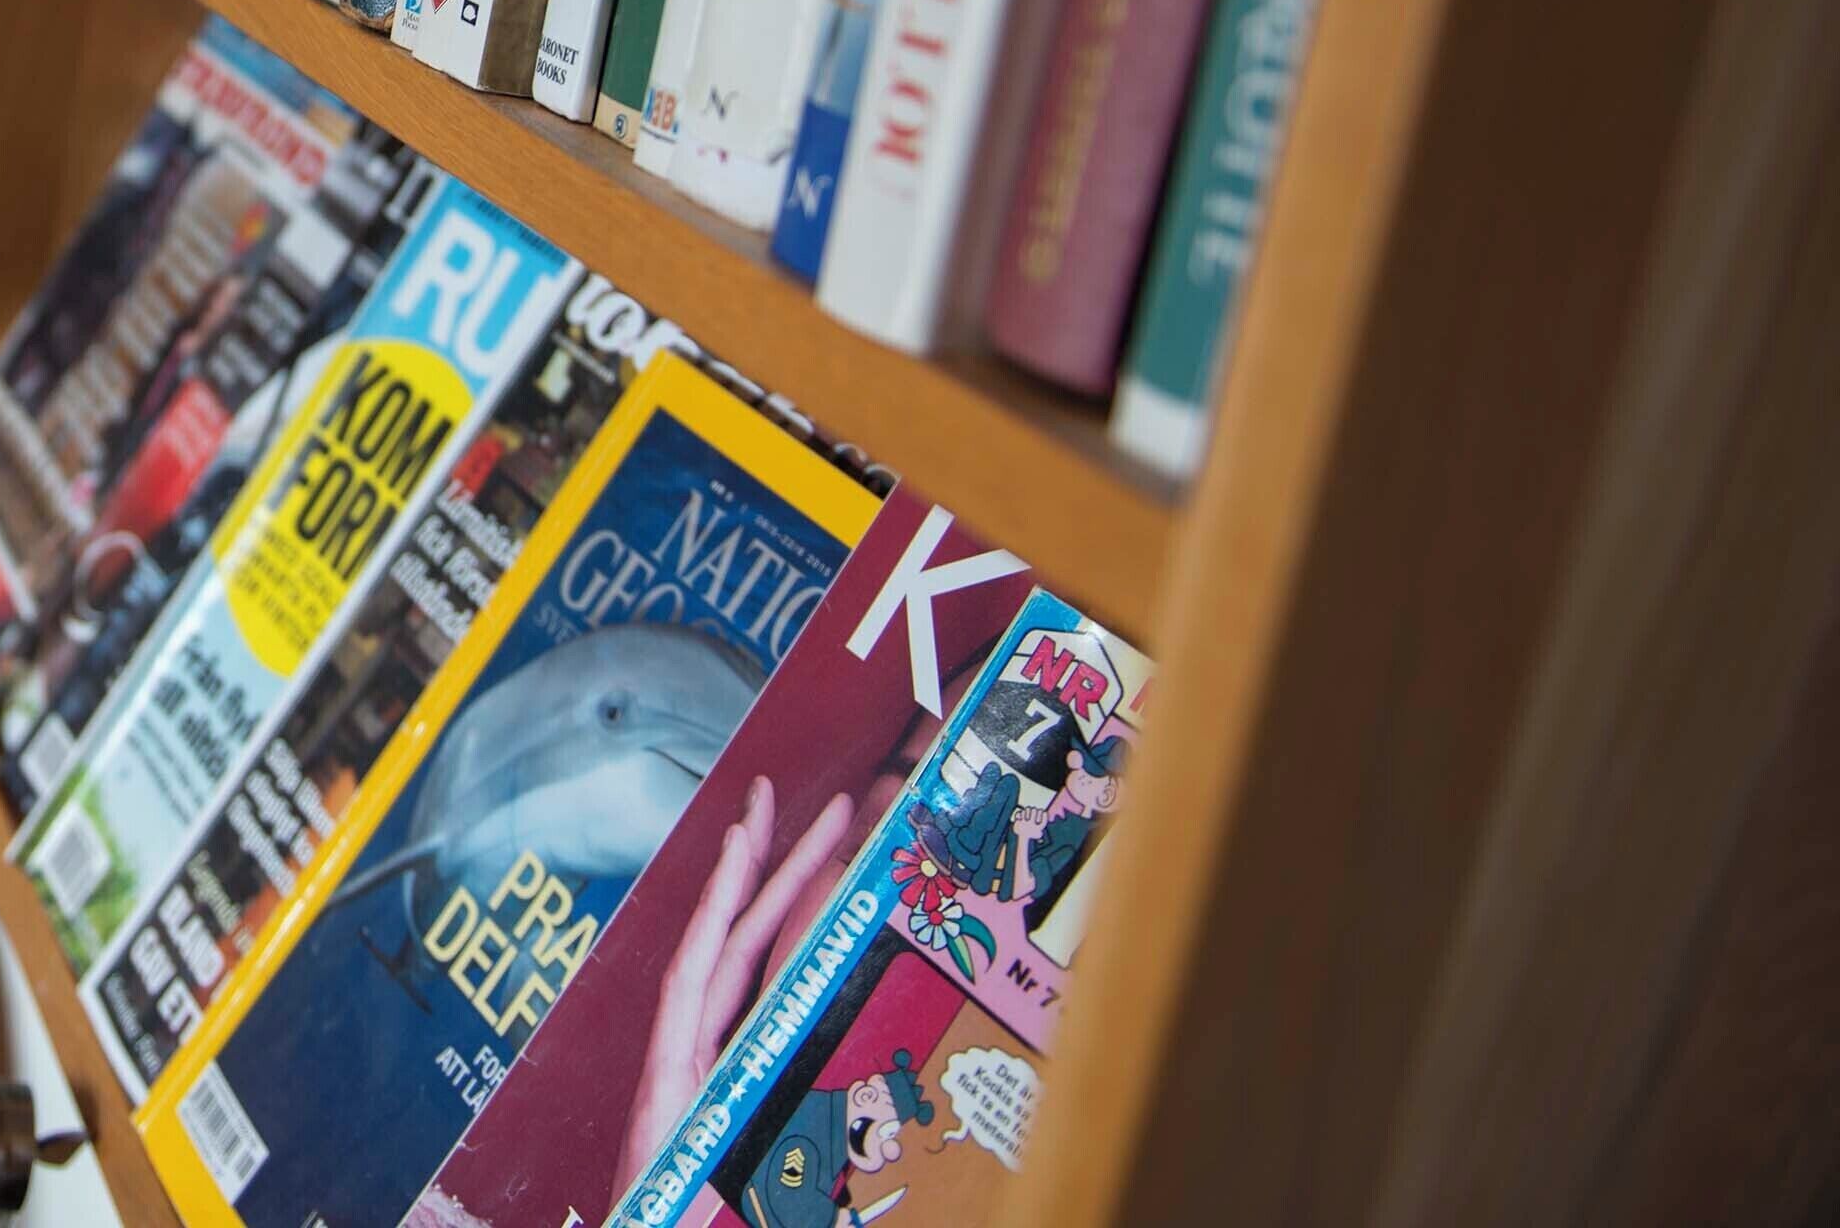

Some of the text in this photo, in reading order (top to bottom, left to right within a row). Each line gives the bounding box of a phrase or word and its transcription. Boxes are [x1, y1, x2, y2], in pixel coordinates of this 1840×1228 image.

[321, 350, 454, 502] KOM
[845, 503, 1033, 720] K
[1020, 634, 1109, 723] NR
[1007, 698, 1062, 763] 7
[488, 847, 600, 989] PRA
[740, 888, 880, 1081] HEMMAVID
[1005, 959, 1063, 1010] Nr 7
[434, 1045, 472, 1087] ATT
[974, 1065, 1014, 1107] Kockis
[995, 1063, 1020, 1090] Det
[957, 1072, 979, 1099] fick
[980, 1093, 994, 1111] ta
[994, 1109, 1011, 1127] en
